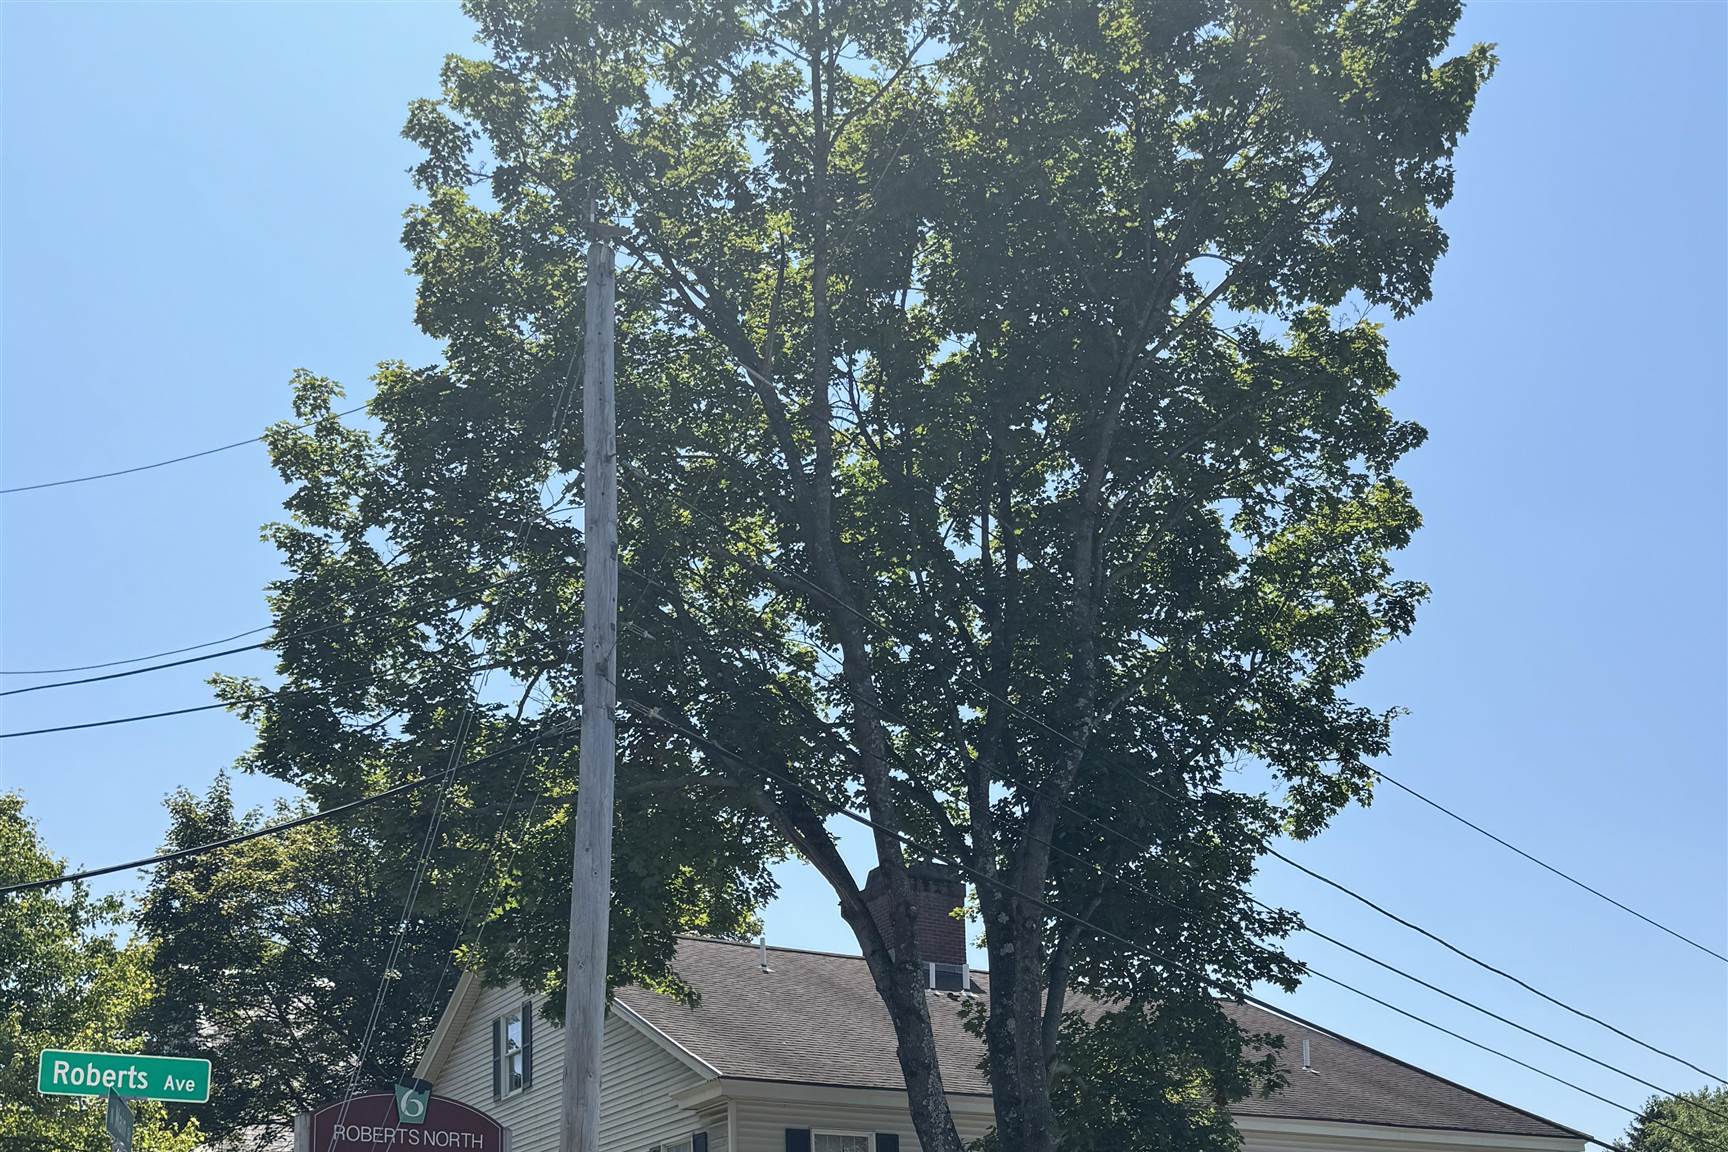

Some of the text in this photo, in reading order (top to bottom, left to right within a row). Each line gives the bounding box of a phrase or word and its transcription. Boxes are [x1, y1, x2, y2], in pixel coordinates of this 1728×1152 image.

[53, 1060, 195, 1092] Roberts Ave
[401, 1089, 424, 1117] 6
[333, 1124, 483, 1149] ROBERTS NORTH
